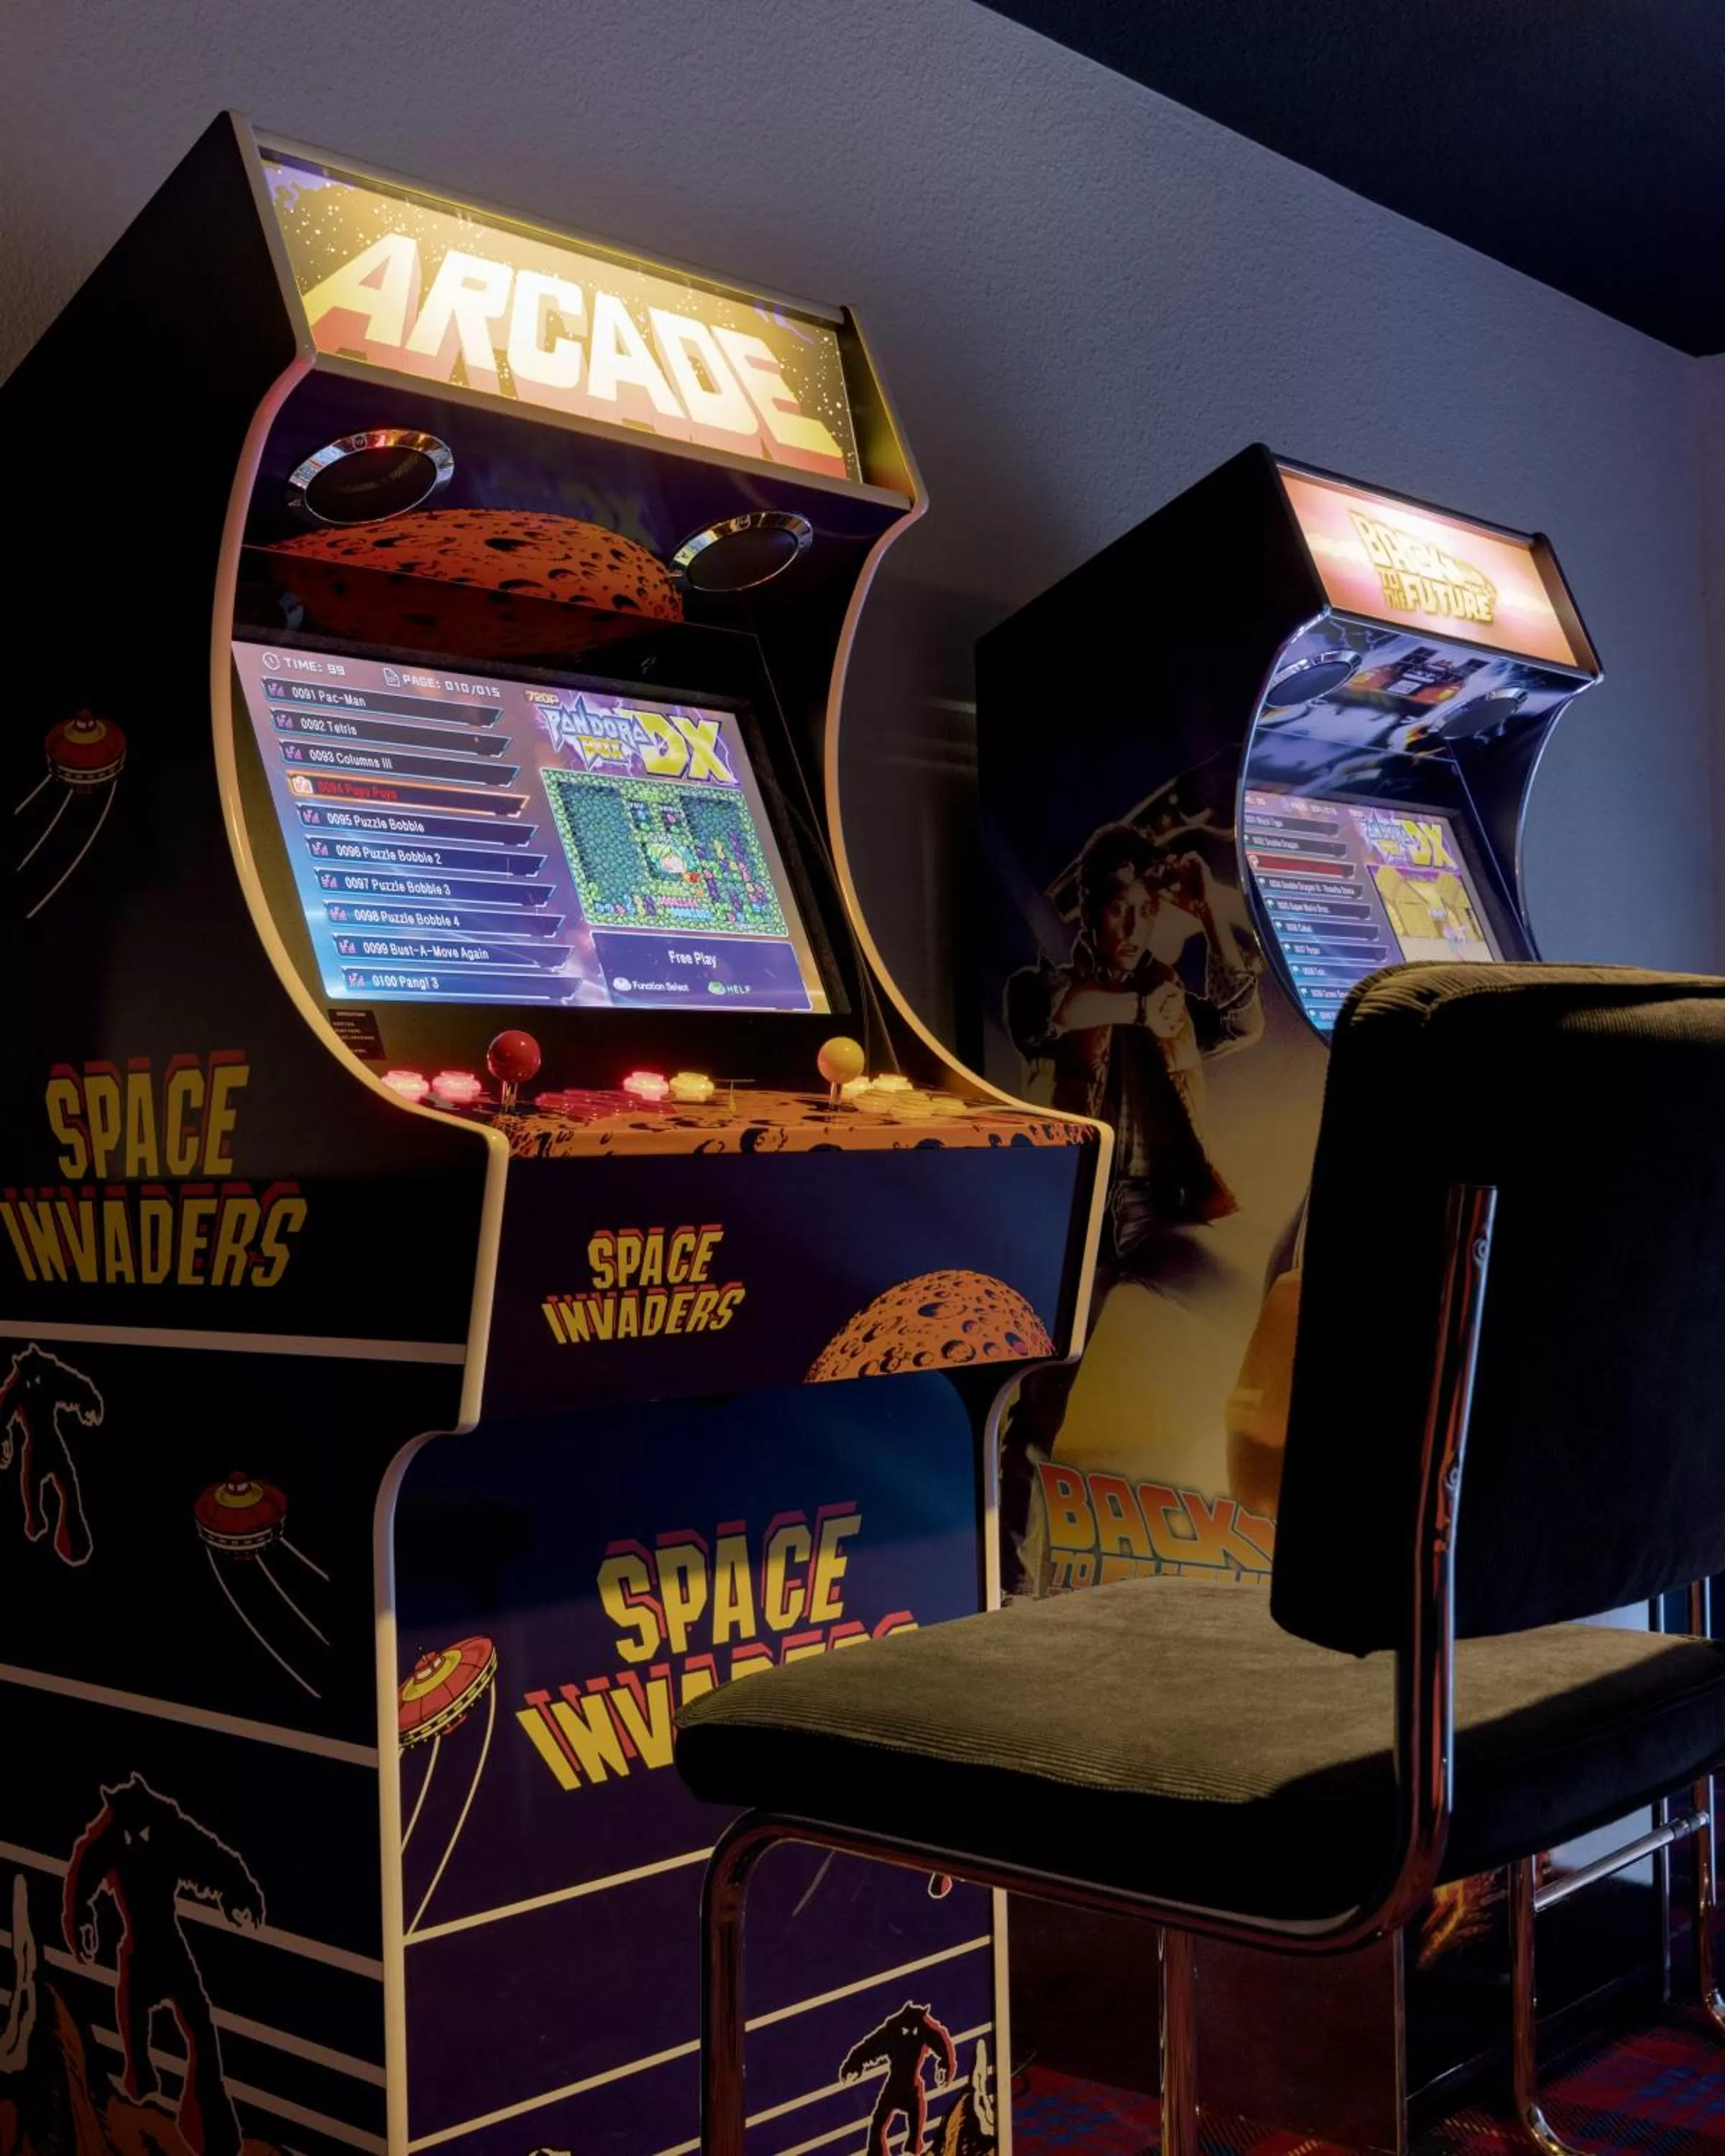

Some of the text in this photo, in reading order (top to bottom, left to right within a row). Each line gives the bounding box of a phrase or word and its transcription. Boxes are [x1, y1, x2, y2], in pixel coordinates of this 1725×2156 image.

[300, 232, 847, 471] ARCADE
[1348, 509, 1465, 585] BACK
[1379, 569, 1399, 589] TO
[1384, 590, 1406, 610] THE
[1399, 571, 1494, 623] FUTURE
[283, 657, 346, 676] TIME: 99
[292, 686, 366, 706] 0091 Pac-Man
[402, 675, 500, 697] PAGE: 010/015
[525, 690, 560, 704] 720P
[300, 718, 357, 735] 0092 Tetris
[538, 694, 654, 752] PANDORA
[617, 709, 739, 785] DX
[309, 749, 334, 763] 0093
[336, 752, 380, 768] Columns
[327, 812, 425, 833] 0095 Puzzle Bobble
[336, 844, 442, 865] 0096 Puzzle Bobble 2
[345, 876, 451, 895] 0097 Puzzle Bobble 3
[354, 909, 460, 927] 0098 Puzzle Bobble 4
[363, 941, 489, 960] 0099 Bust-A-Move Again
[668, 949, 717, 969] Free Play
[372, 975, 397, 987] 0100
[431, 978, 438, 989] 3
[632, 981, 689, 992] Function Select
[727, 985, 751, 995] HELP
[45, 1050, 250, 1179] SPACE
[0, 1182, 308, 1287] INVADERS
[587, 1225, 724, 1289] SPACE
[541, 1281, 746, 1345] INVADERS
[1038, 1461, 1271, 1571] BACK
[1051, 1549, 1095, 1588] TO
[597, 1501, 862, 1664] SPACE
